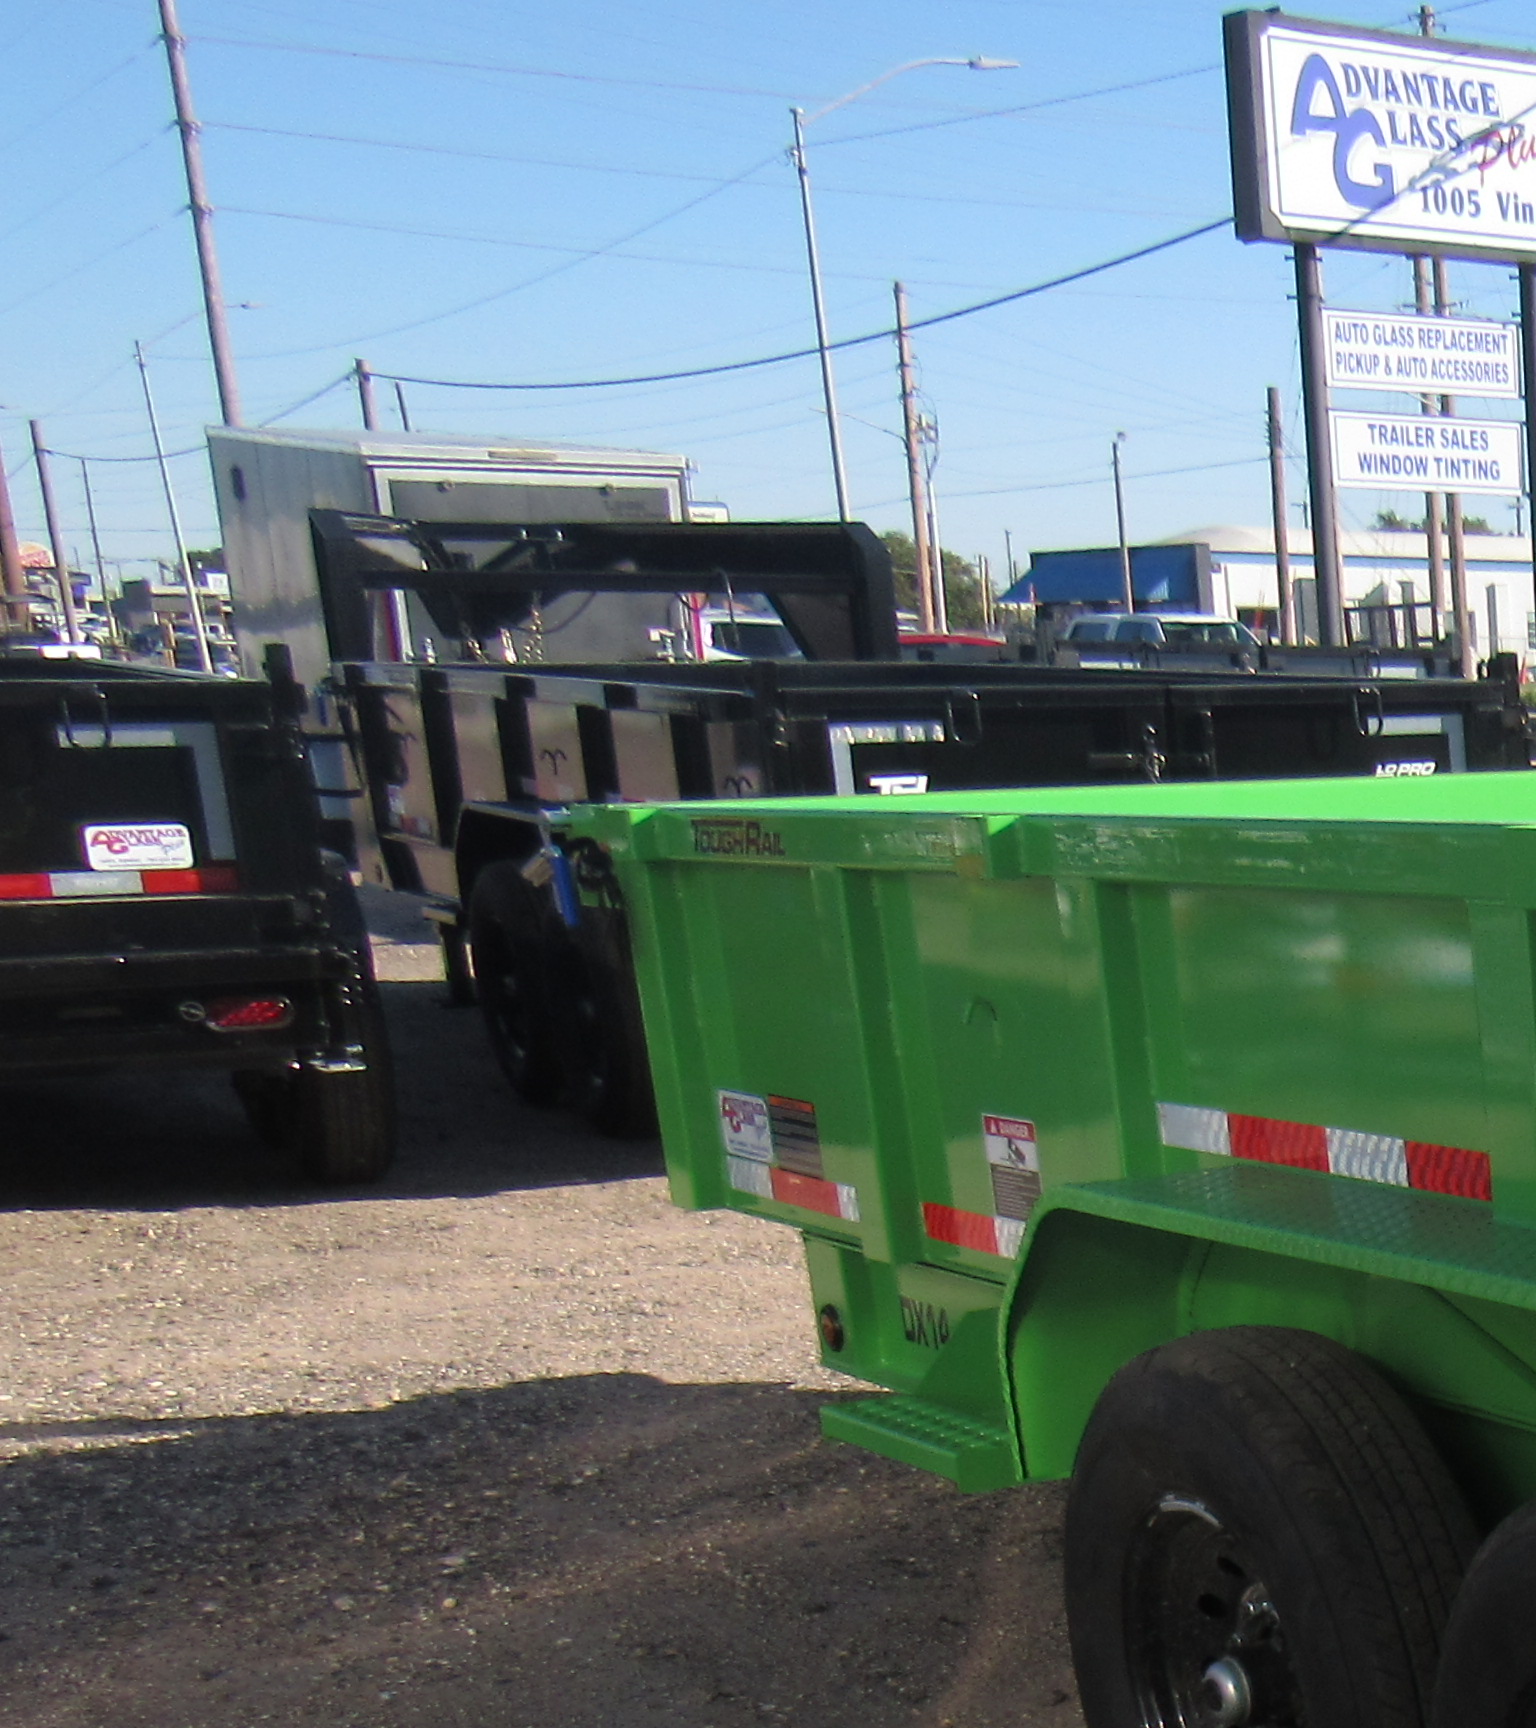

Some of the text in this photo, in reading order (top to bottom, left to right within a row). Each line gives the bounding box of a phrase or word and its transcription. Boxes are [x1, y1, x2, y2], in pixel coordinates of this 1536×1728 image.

[1291, 53, 1501, 136] ADVANTAGE
[1421, 186, 1482, 218] 1005
[1335, 321, 1508, 355] AUTO GLASS REPLACEMENT
[1336, 351, 1509, 384] PICKUP & AUTO ACCESSORIES
[1368, 423, 1489, 450] TRAILER SALES
[1358, 452, 1500, 481] WINDOW TINTING
[1376, 762, 1436, 777] LO PRO
